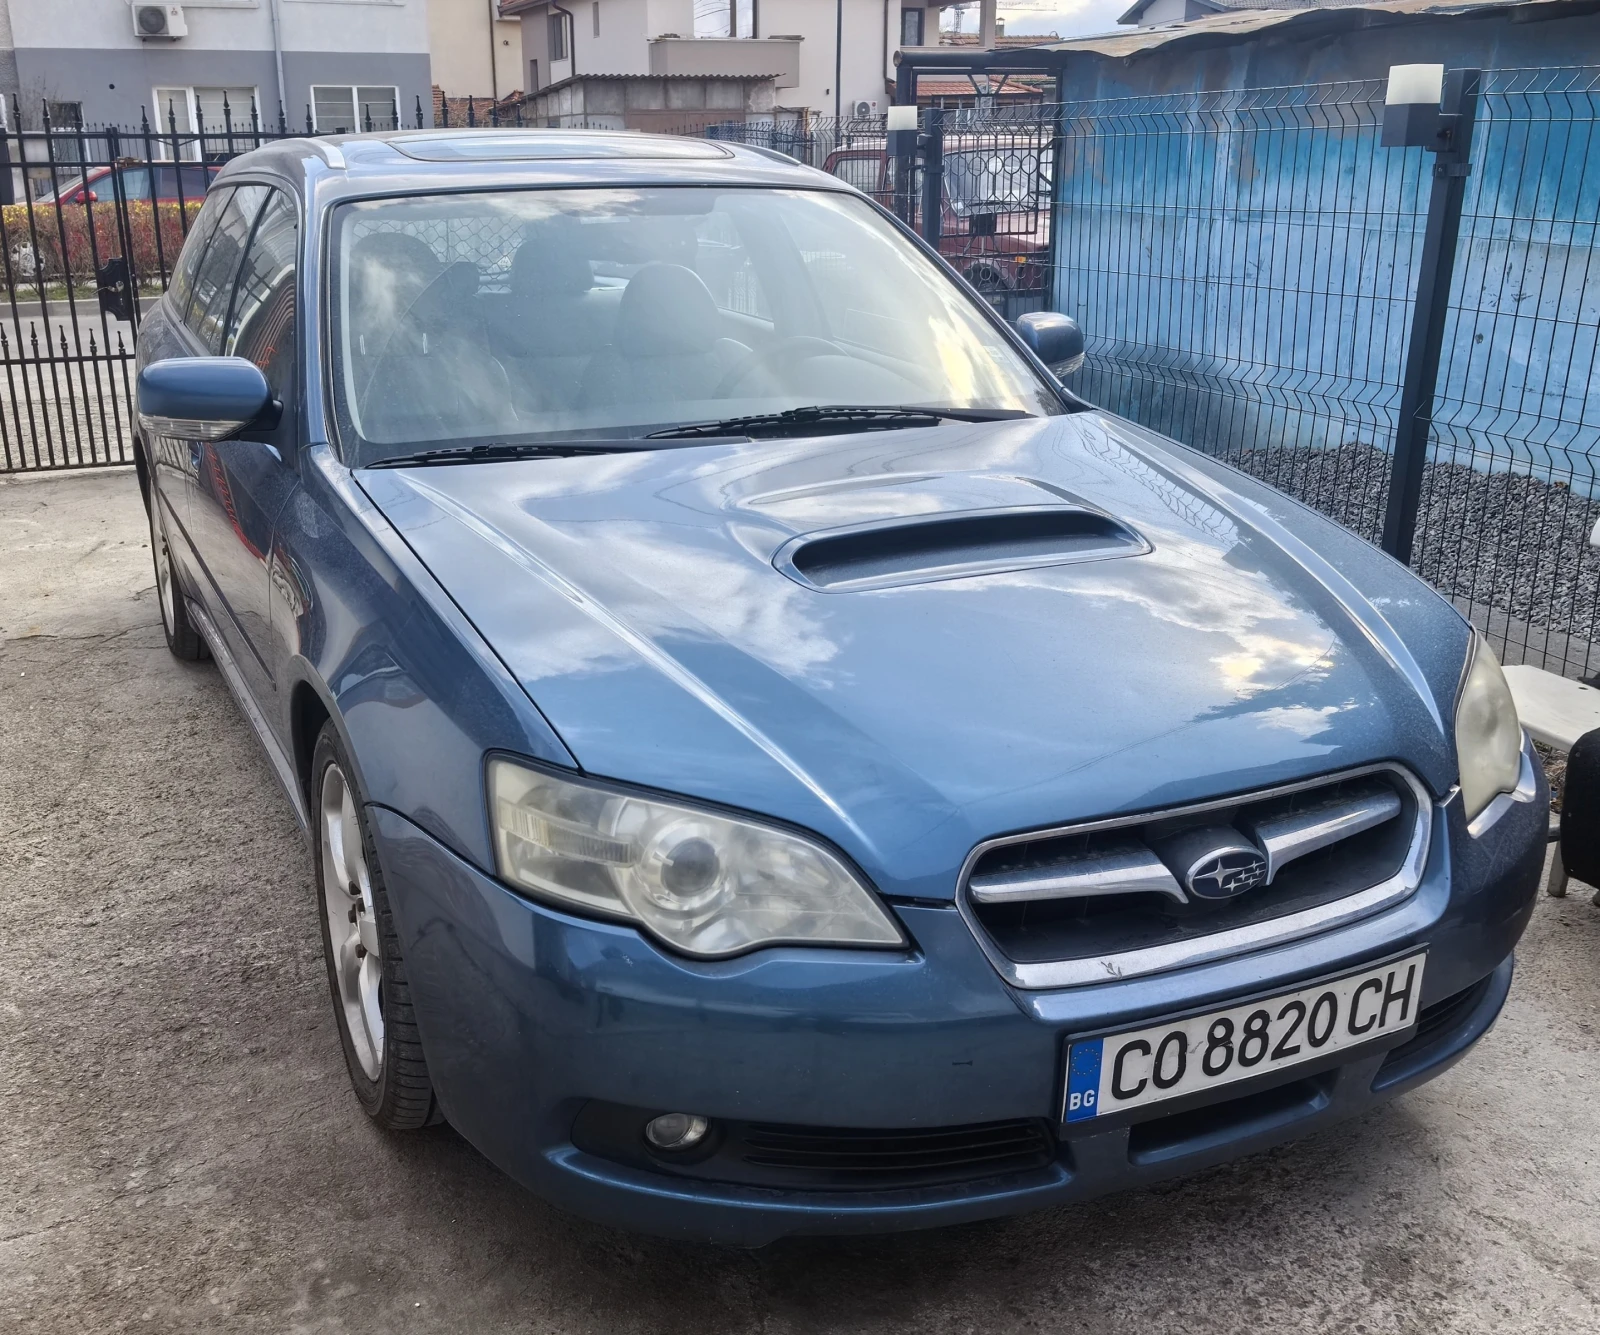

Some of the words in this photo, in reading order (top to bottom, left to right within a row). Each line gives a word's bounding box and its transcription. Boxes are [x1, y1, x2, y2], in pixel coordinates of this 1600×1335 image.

[1111, 1031, 1187, 1100] CO
[1202, 991, 1338, 1076] 8820
[1347, 964, 1416, 1036] CH
[1069, 1089, 1095, 1111] BG
